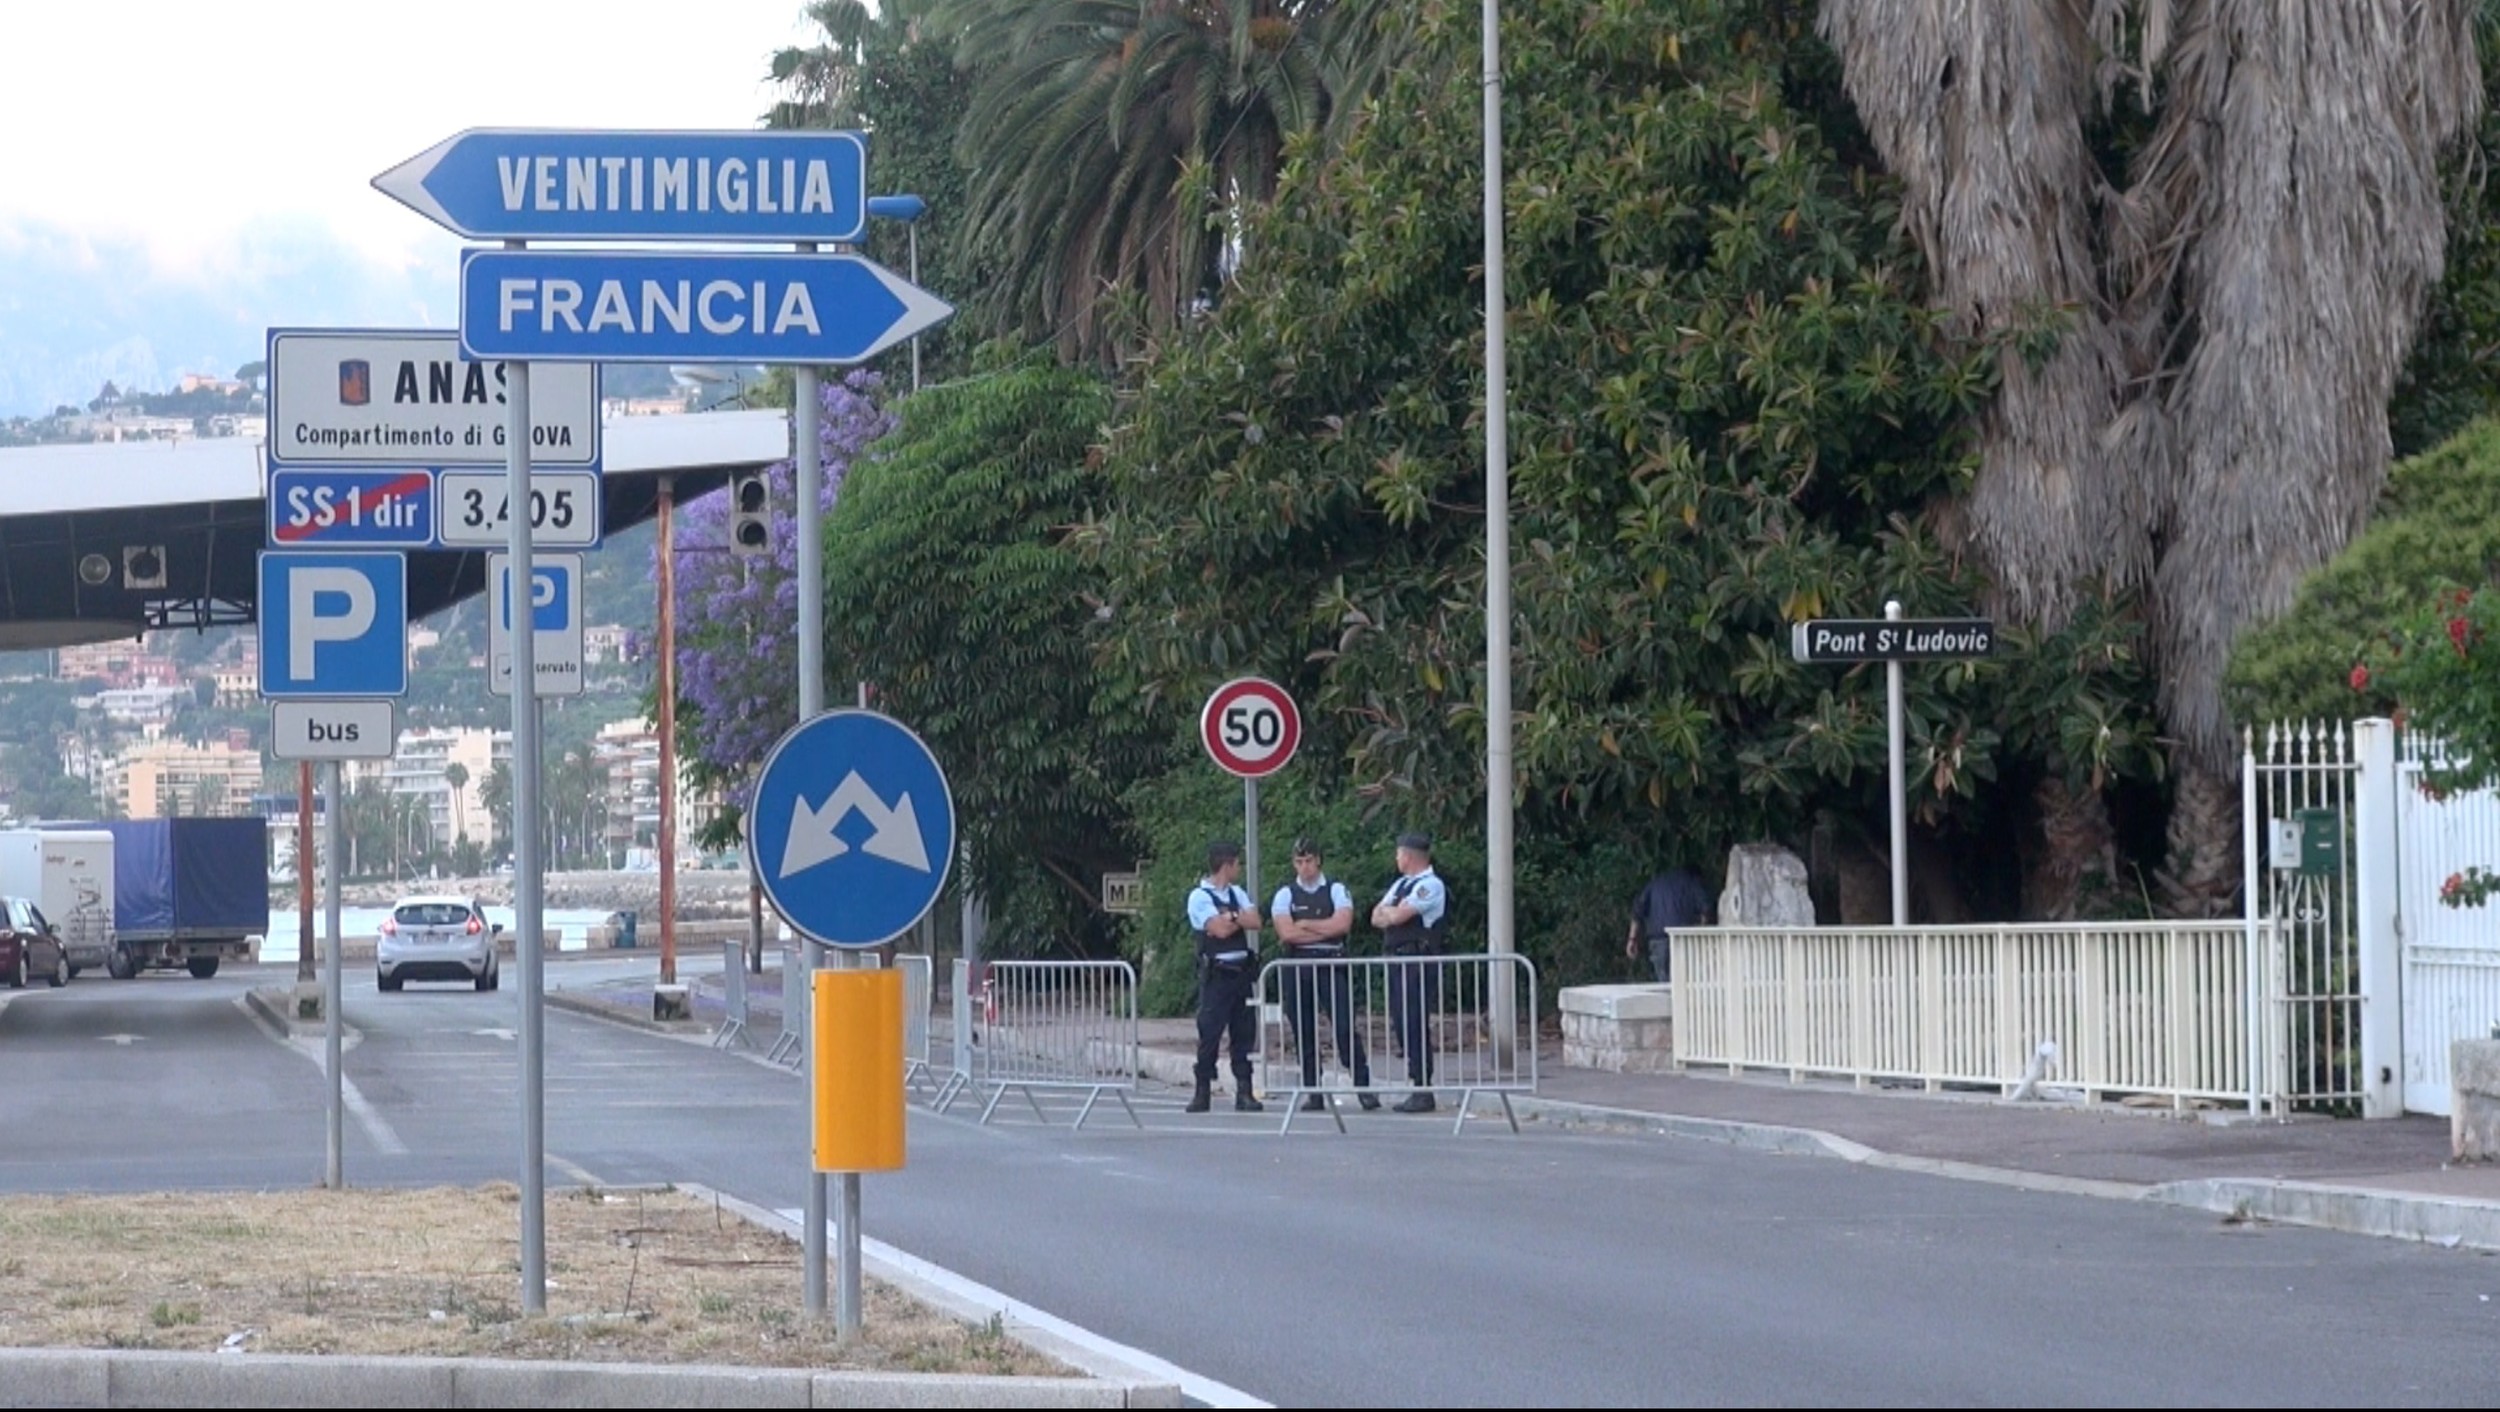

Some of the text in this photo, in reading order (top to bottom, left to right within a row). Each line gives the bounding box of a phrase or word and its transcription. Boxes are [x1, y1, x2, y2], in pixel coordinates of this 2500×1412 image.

[498, 156, 834, 214] VENTIMIGLIA
[499, 278, 821, 336] FRANCIA
[296, 423, 572, 449] Compartimento di GOVA
[288, 485, 418, 528] SS 1 dir
[289, 567, 377, 680] P
[1815, 628, 1866, 652] Pont
[1905, 627, 1989, 652] Ludovic
[535, 661, 577, 674] servato
[308, 718, 360, 743] bus
[1225, 707, 1280, 748] 50
